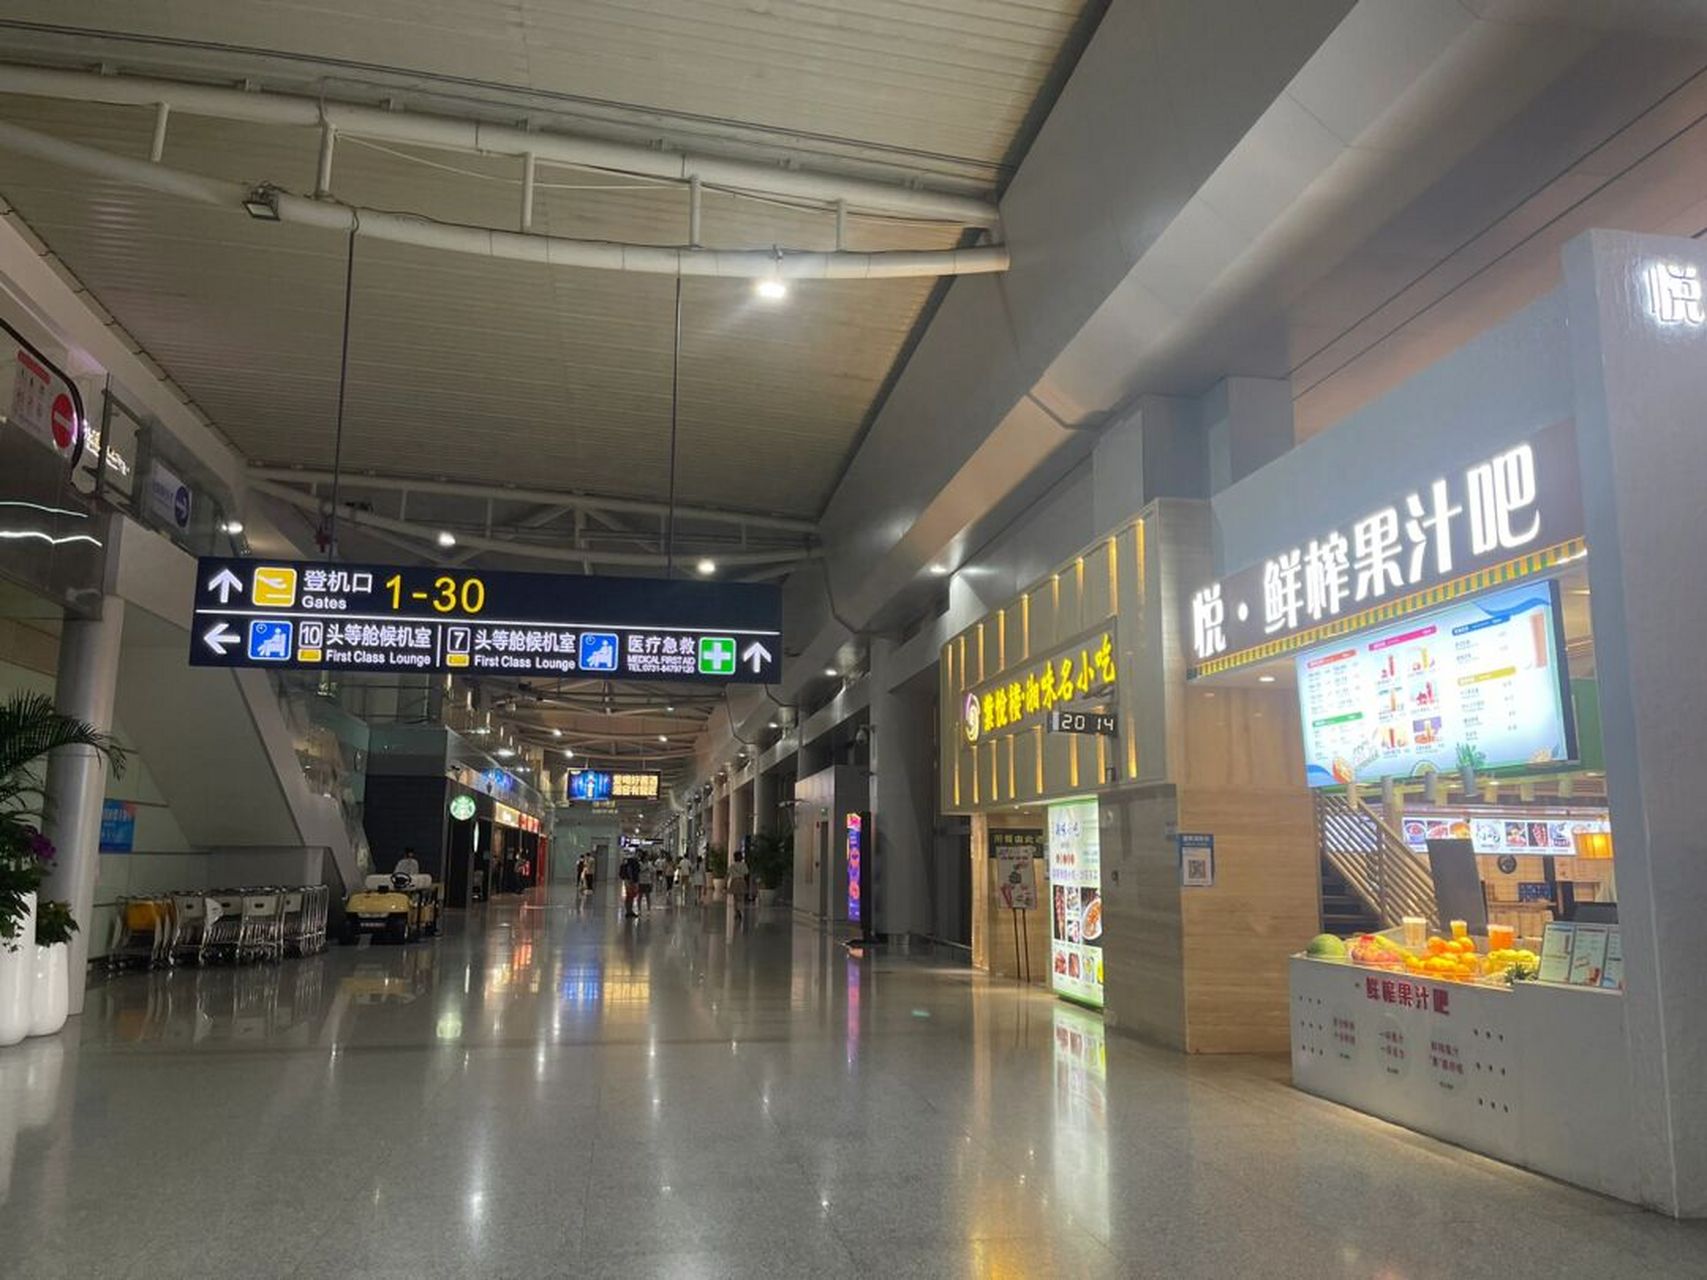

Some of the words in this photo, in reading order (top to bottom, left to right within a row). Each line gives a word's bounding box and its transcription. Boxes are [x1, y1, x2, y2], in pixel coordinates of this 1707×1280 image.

[1642, 263, 1706, 326] 悦
[303, 569, 373, 594] 登机口
[301, 595, 347, 611] Gates
[385, 575, 485, 614] 1-30
[302, 625, 321, 646] 10
[326, 622, 432, 649] 头等舱候机室
[453, 631, 464, 650] 7
[474, 630, 576, 653] 头等舱候机室
[627, 634, 696, 655] 医疗急救
[325, 649, 352, 663] First
[353, 650, 386, 664] Class
[389, 651, 432, 667] Lounge
[474, 654, 500, 668] First
[501, 655, 532, 669] Class
[535, 656, 576, 671] Lounge
[1061, 714, 1086, 731] 20
[1096, 717, 1115, 732] 14
[1365, 976, 1451, 1016] 鲜榨果汁吧
